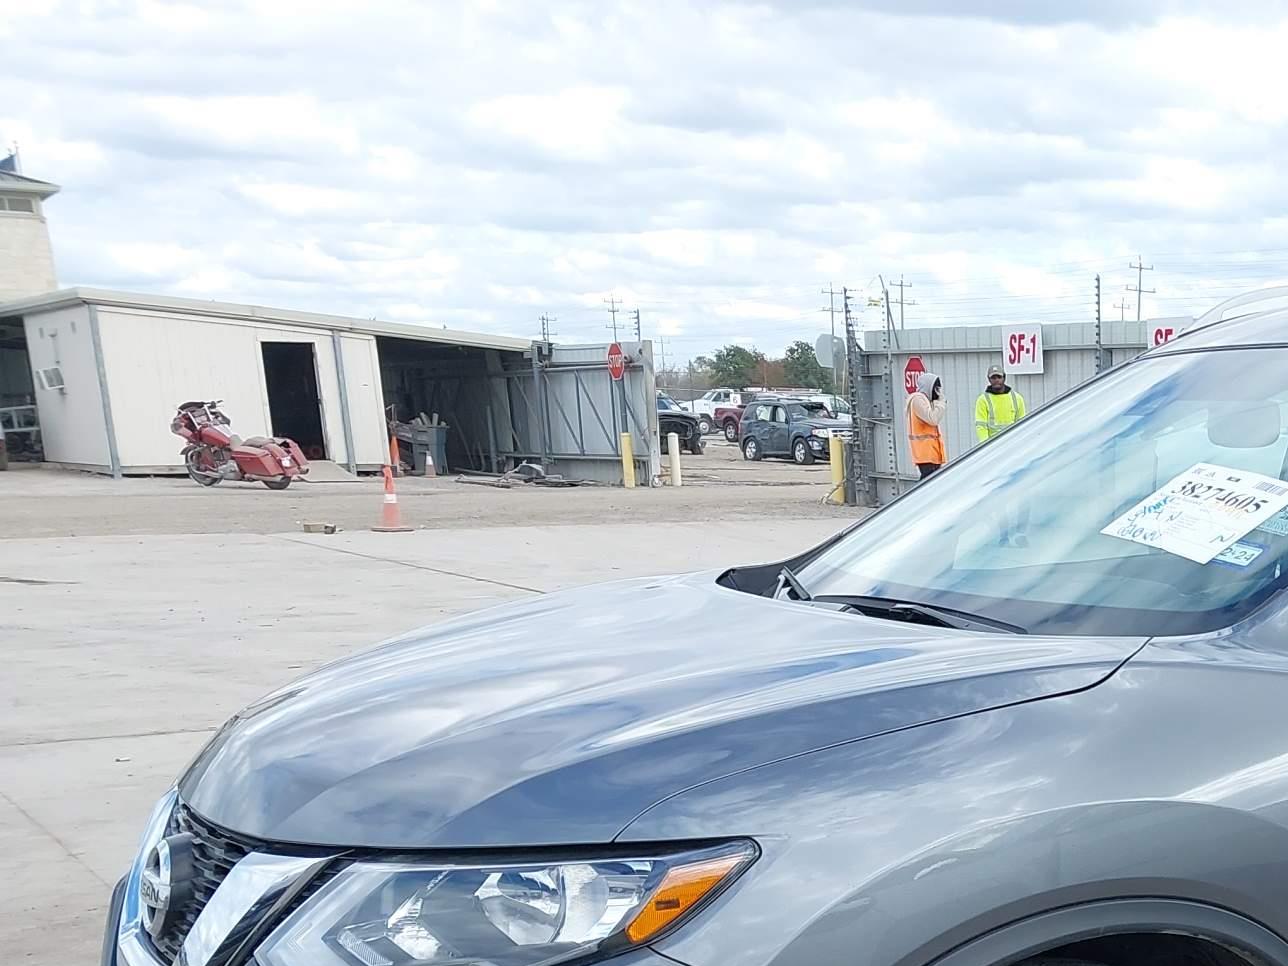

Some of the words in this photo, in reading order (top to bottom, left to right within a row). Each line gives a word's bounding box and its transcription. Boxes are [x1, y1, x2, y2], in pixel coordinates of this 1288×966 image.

[609, 354, 622, 368] STOP
[1009, 333, 1036, 364] SF-1
[1171, 481, 1269, 513] 38274605
